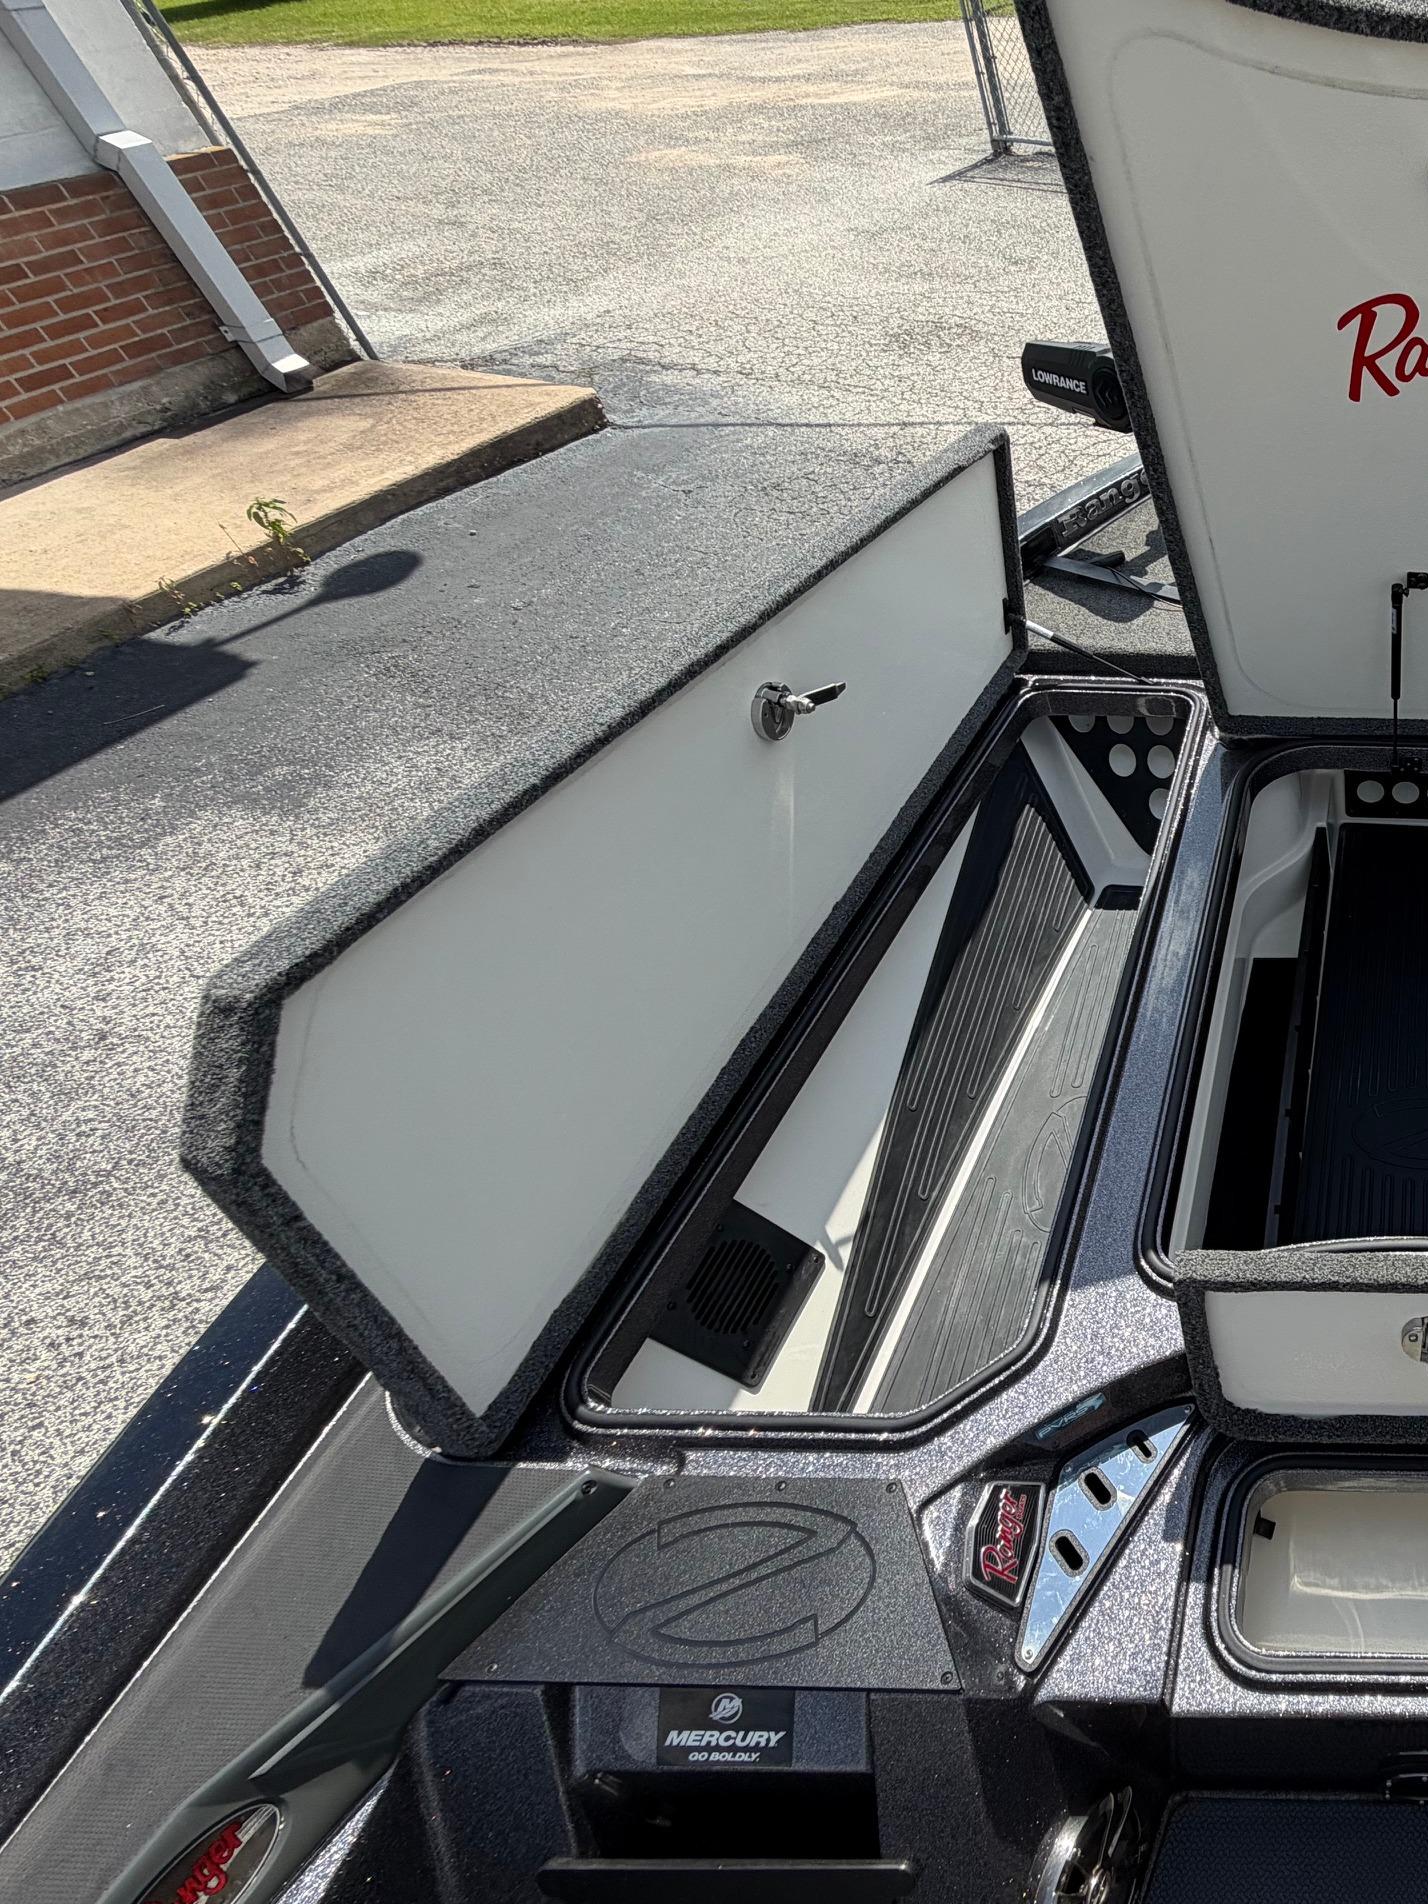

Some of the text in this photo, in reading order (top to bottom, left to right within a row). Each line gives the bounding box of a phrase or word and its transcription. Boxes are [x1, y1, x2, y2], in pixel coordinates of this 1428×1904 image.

[1031, 368, 1088, 395] LOWRANCE
[980, 1488, 1024, 1585] Ranger
[664, 1730, 787, 1748] MERCURY
[688, 1752, 707, 1761] GO
[143, 1823, 244, 1904] nger
